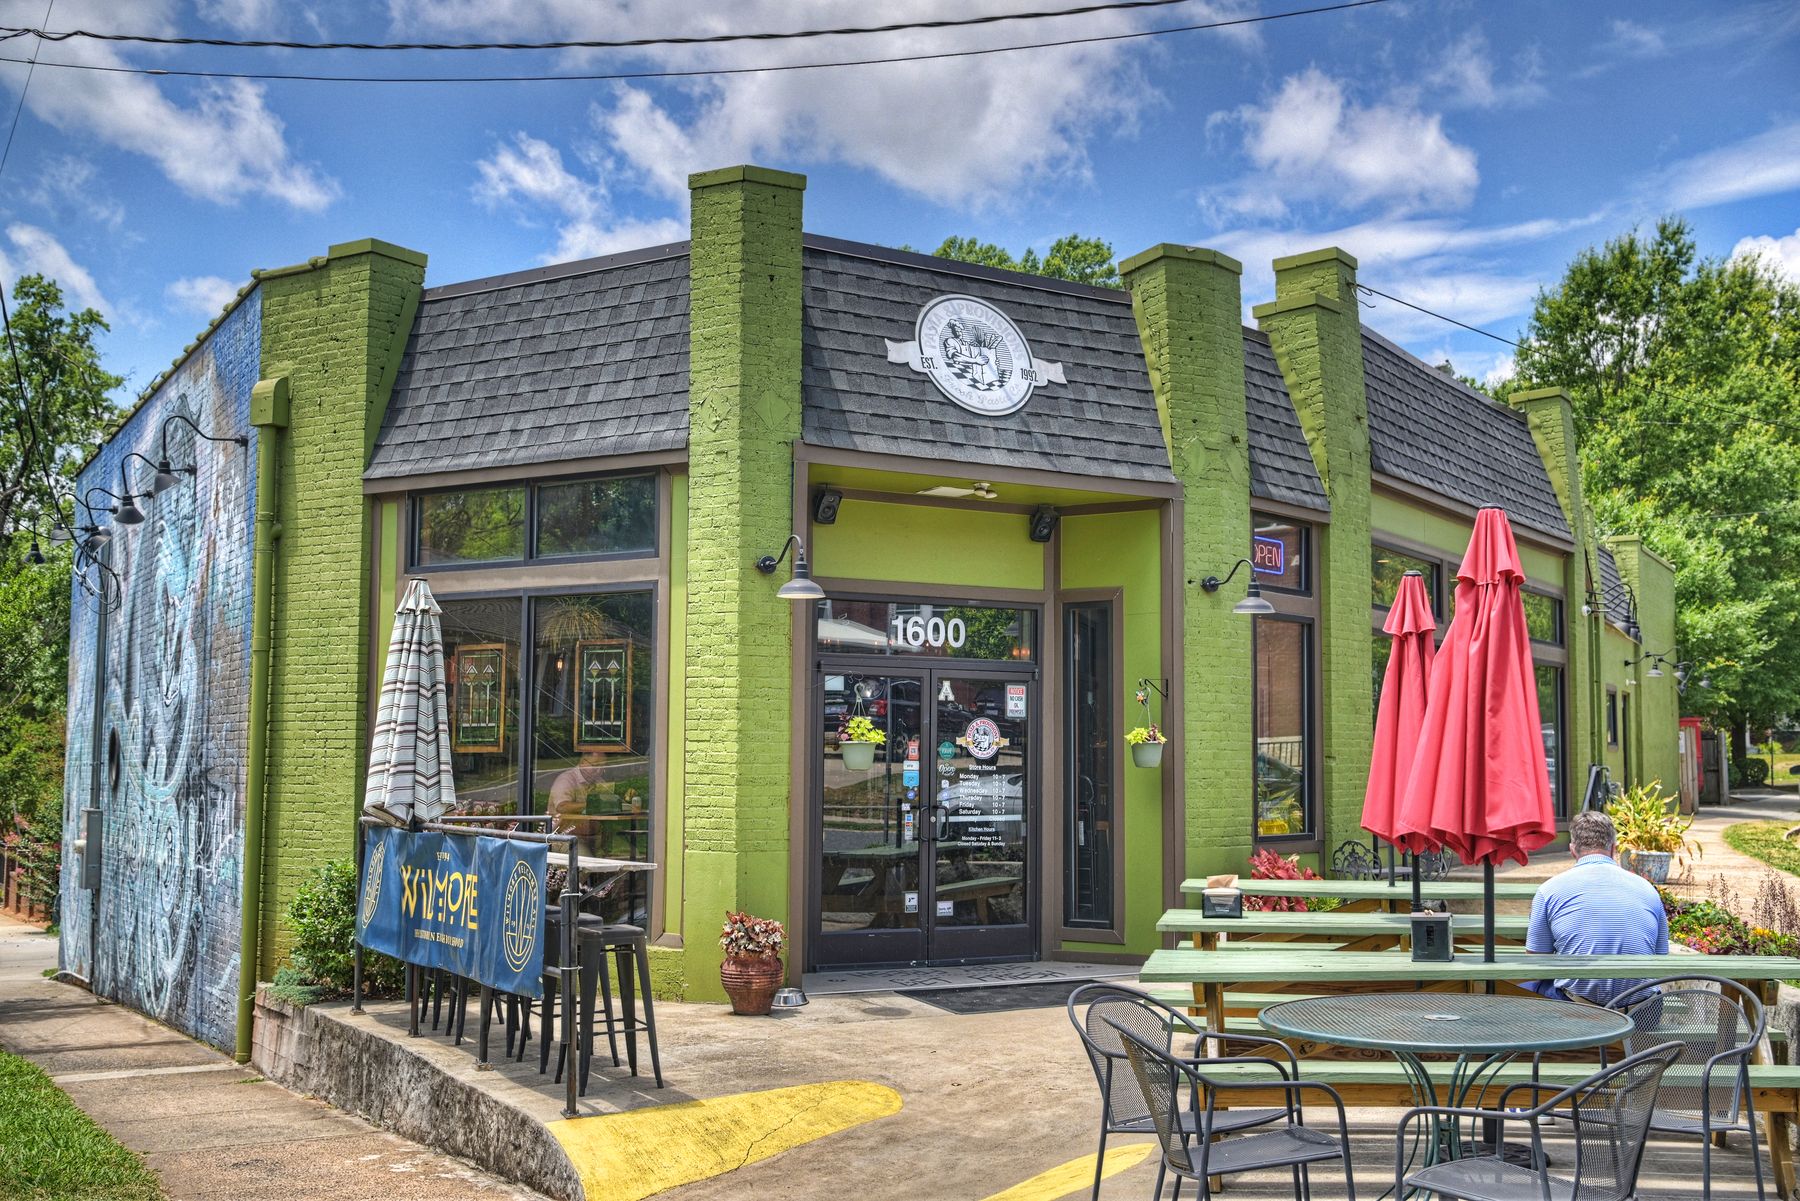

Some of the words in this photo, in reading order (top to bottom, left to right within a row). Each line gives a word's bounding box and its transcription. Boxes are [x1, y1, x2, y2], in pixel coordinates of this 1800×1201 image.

[924, 312, 946, 350] PASTA
[944, 304, 955, 318] &
[959, 302, 1025, 361] PROVISIONS
[921, 357, 938, 370] EST.
[1020, 367, 1039, 383] 1992
[891, 616, 966, 648] 1600
[938, 680, 955, 701] A
[958, 808, 981, 816] Saturday
